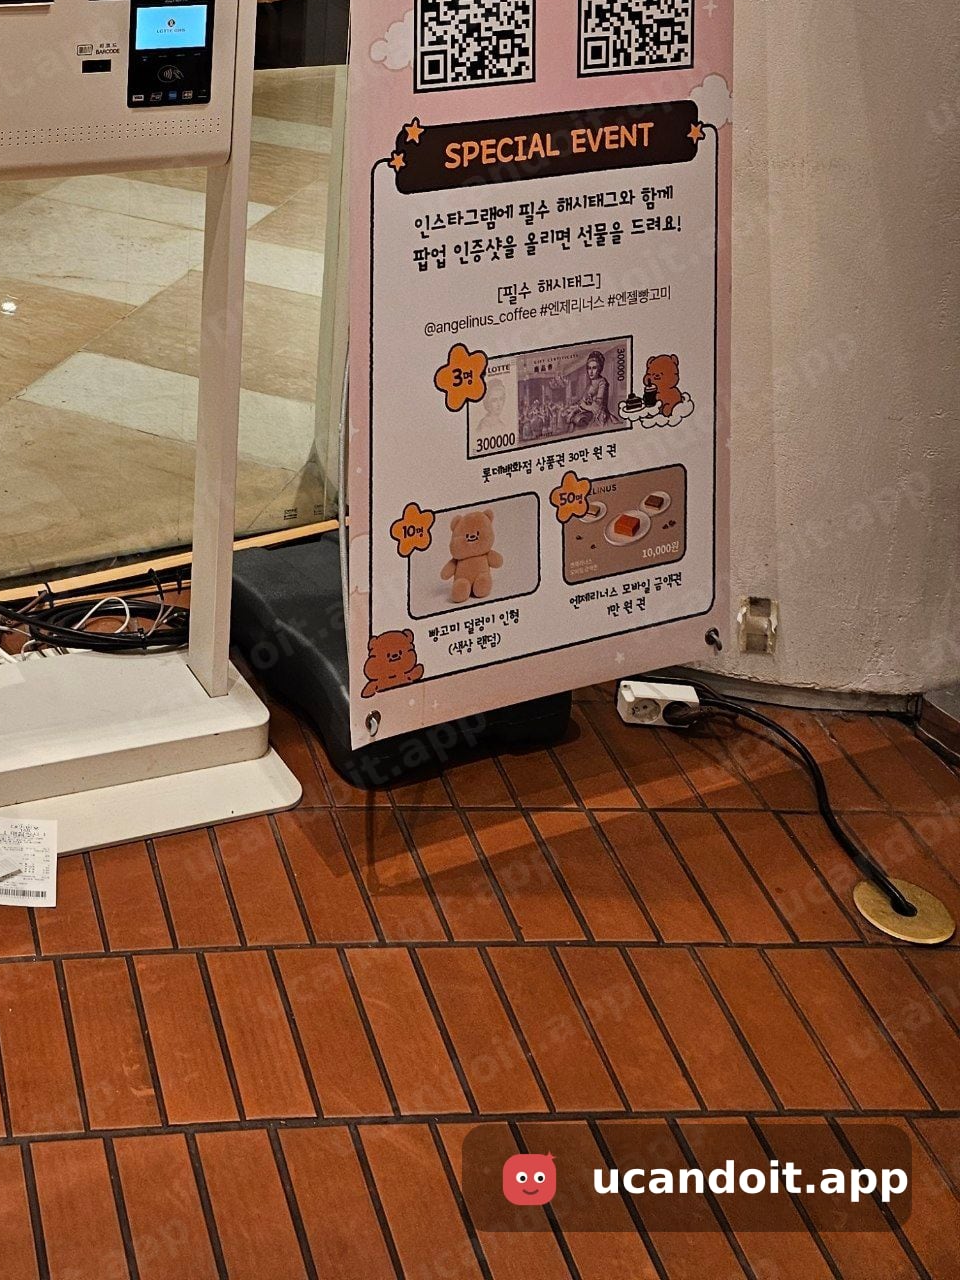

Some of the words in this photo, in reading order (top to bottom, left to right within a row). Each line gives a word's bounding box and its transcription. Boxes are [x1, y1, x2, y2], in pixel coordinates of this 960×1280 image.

[445, 133, 560, 169] SPECIAL
[571, 122, 654, 154] EVENT
[415, 206, 514, 238] 인스타그램에
[519, 201, 550, 225] 필수
[556, 190, 635, 213] 해시태그와
[642, 186, 673, 211] 함께
[413, 245, 447, 271] 팝업
[454, 237, 517, 265] 인증샷을
[524, 228, 571, 255] 올리면
[578, 222, 623, 247] 선물을
[631, 216, 681, 235] 드려요!
[498, 282, 531, 304] [필수
[538, 274, 601, 293] 해시태그]
[424, 306, 537, 337] @angelinus_coffee
[540, 295, 605, 317] #엔제리너스
[608, 285, 671, 307] #엔젤빵고미
[452, 368, 473, 386] 3명
[487, 363, 511, 374] LOTTE
[476, 432, 516, 453] 300000
[482, 460, 532, 482] 롯데백화점
[536, 455, 565, 472] 상품권
[568, 450, 589, 463] 30만
[593, 446, 603, 459] 원
[607, 443, 616, 457] 권
[560, 491, 583, 505] 50명
[402, 524, 424, 538] 10명
[642, 542, 679, 559] 10,000원
[570, 588, 618, 608] 엔제리너스
[622, 580, 650, 595] 모바일
[654, 573, 682, 591] 금액권
[607, 602, 620, 615] 1만
[624, 601, 633, 613] 원
[636, 598, 646, 611] 권
[429, 623, 459, 641] 빵고미
[500, 609, 520, 625] 인형
[448, 640, 472, 655] (색상
[476, 635, 501, 651] 랜덤)
